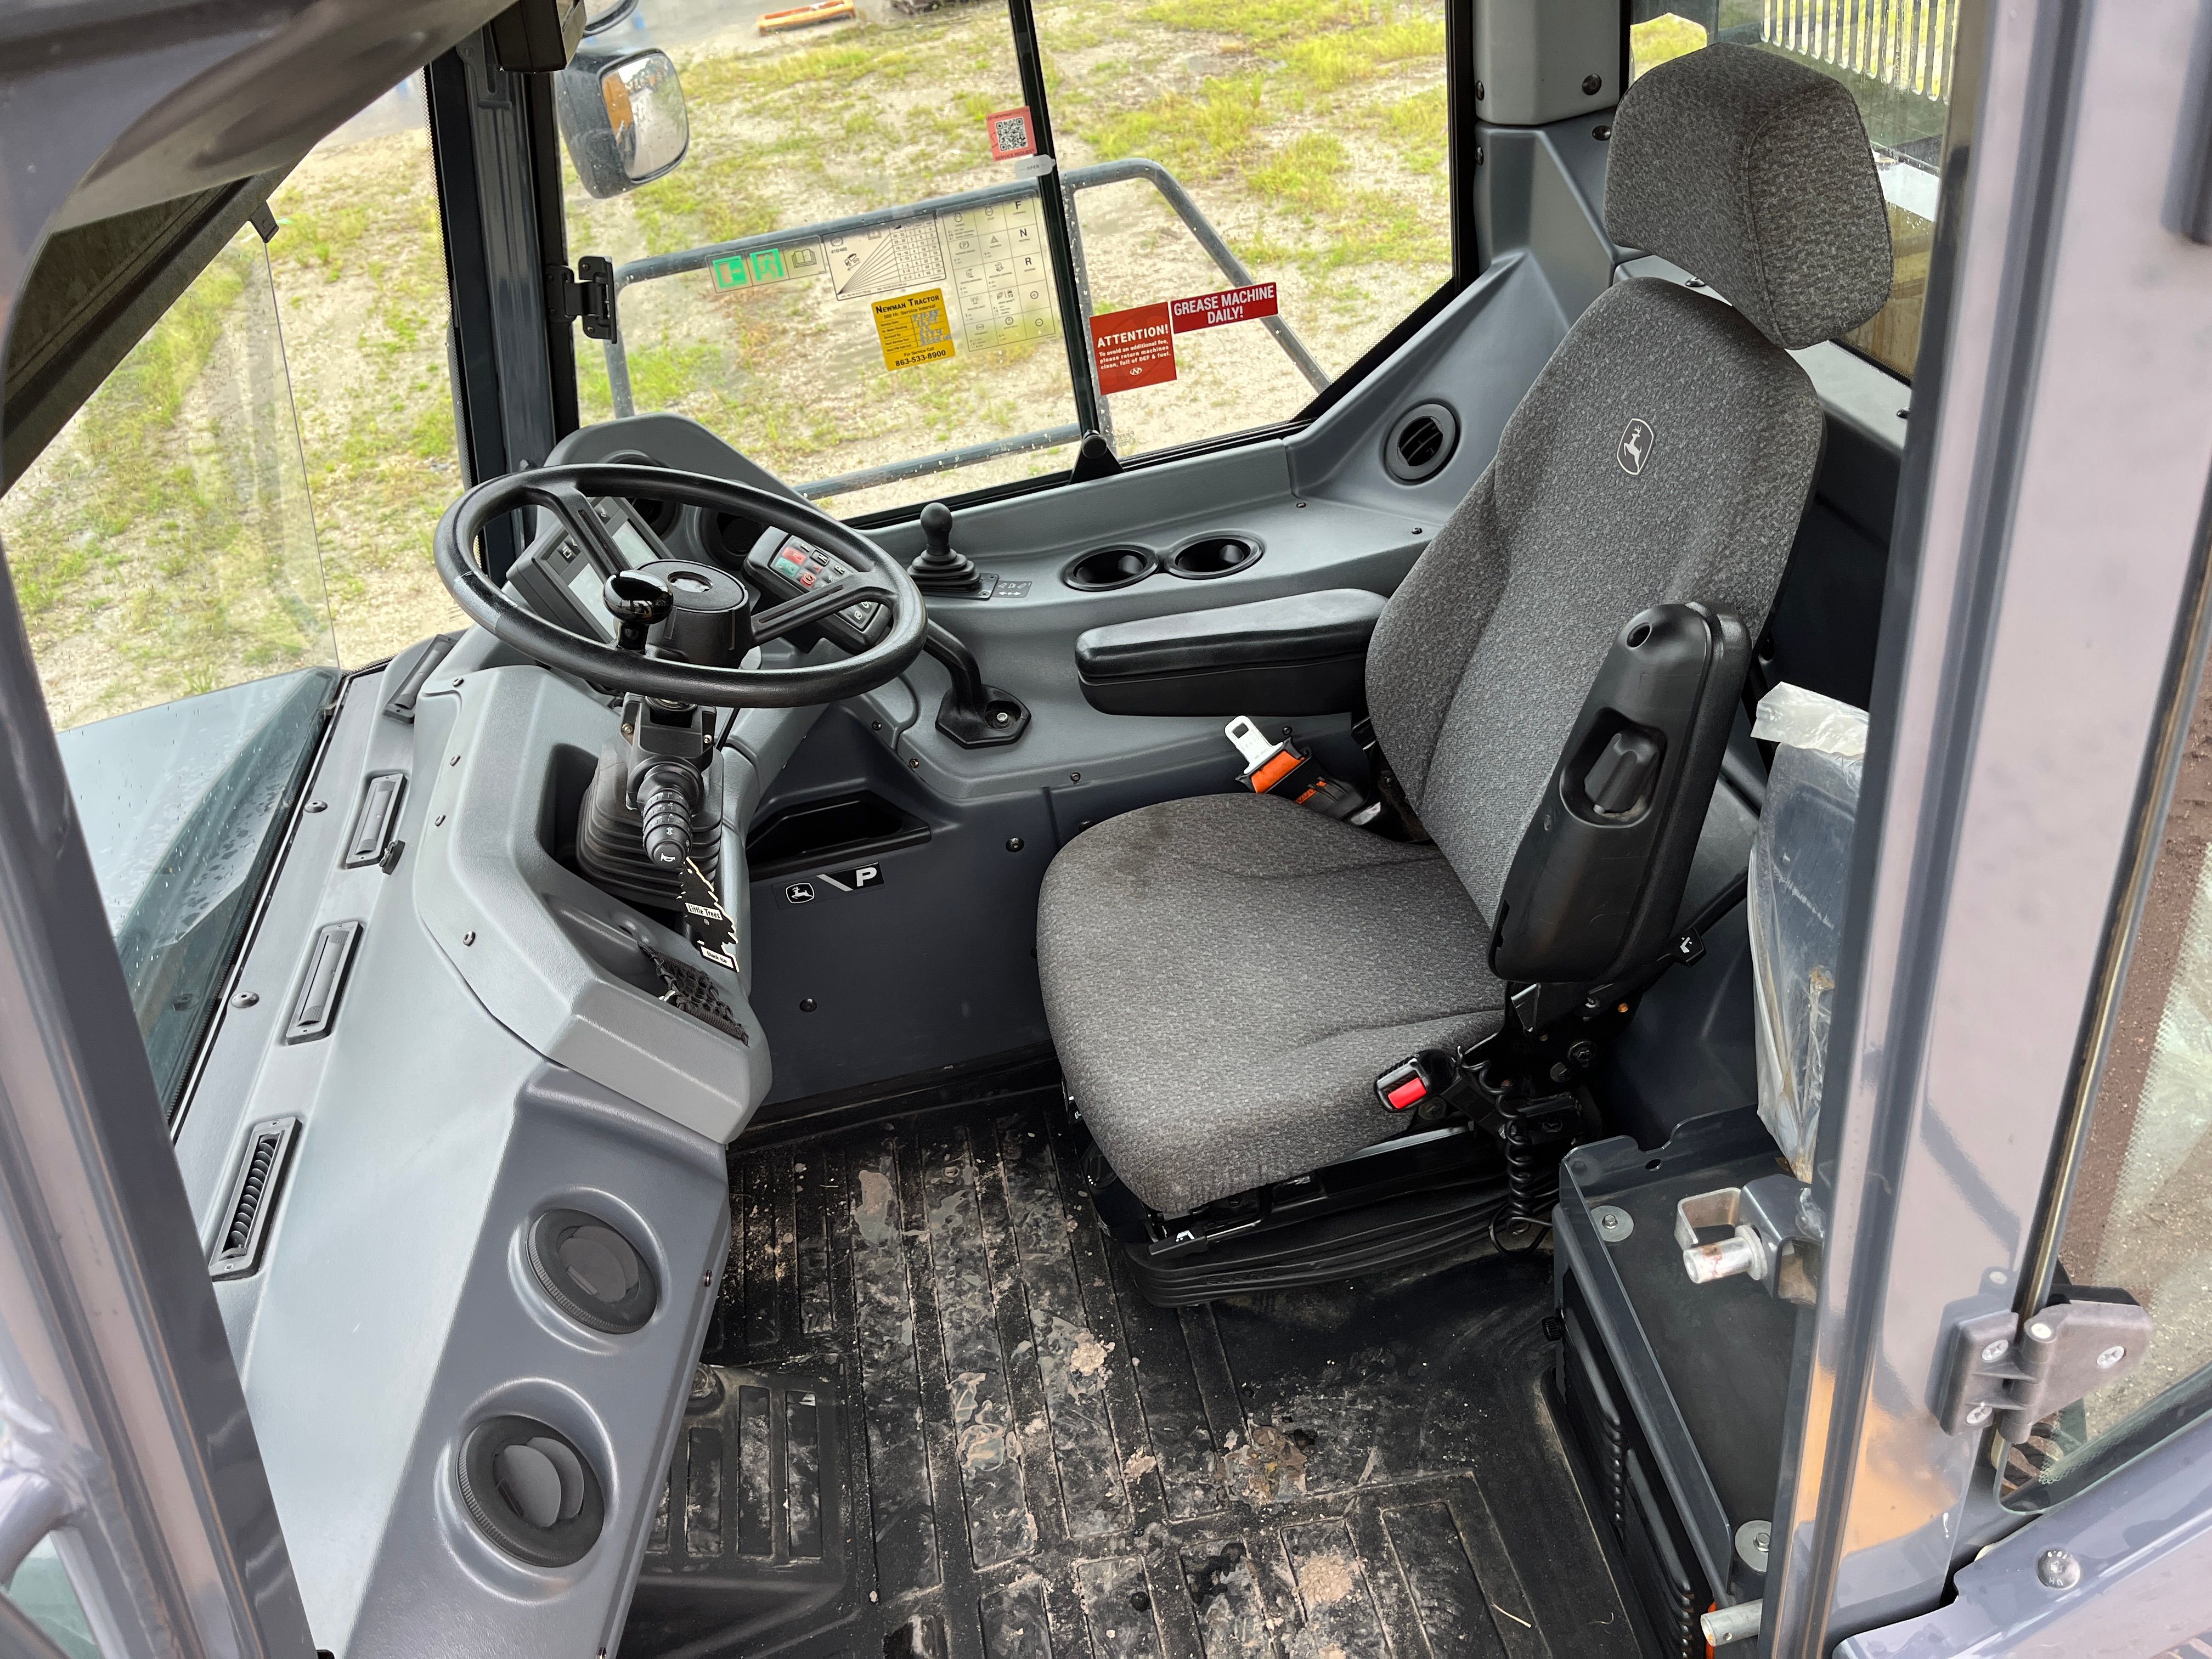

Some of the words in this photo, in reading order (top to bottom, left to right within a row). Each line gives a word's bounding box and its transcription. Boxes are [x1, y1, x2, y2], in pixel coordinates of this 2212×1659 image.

[1015, 201, 1021, 210] F
[1020, 228, 1028, 238] N
[1025, 257, 1032, 266] R
[876, 303, 906, 313] NEWMAN
[907, 295, 940, 306] TRACTOR
[1173, 295, 1219, 316] GREASE
[1221, 285, 1274, 304] MACHINE
[1207, 306, 1244, 324] DAILY!
[1097, 324, 1169, 348] ATTENTION!
[1099, 356, 1120, 364] please
[1141, 346, 1169, 356] machines
[1107, 348, 1121, 357] avoid
[1130, 341, 1157, 351] additional
[896, 350, 946, 366] 863-533-8900
[1101, 362, 1119, 370] clean,
[1120, 358, 1131, 366] full
[1157, 351, 1171, 359] fuel.
[800, 543, 809, 552] F
[817, 553, 828, 563] N
[834, 565, 845, 574] R
[856, 867, 877, 887] P
[688, 904, 704, 915] Little
[703, 908, 720, 919] Trees
[707, 951, 719, 960] Black
